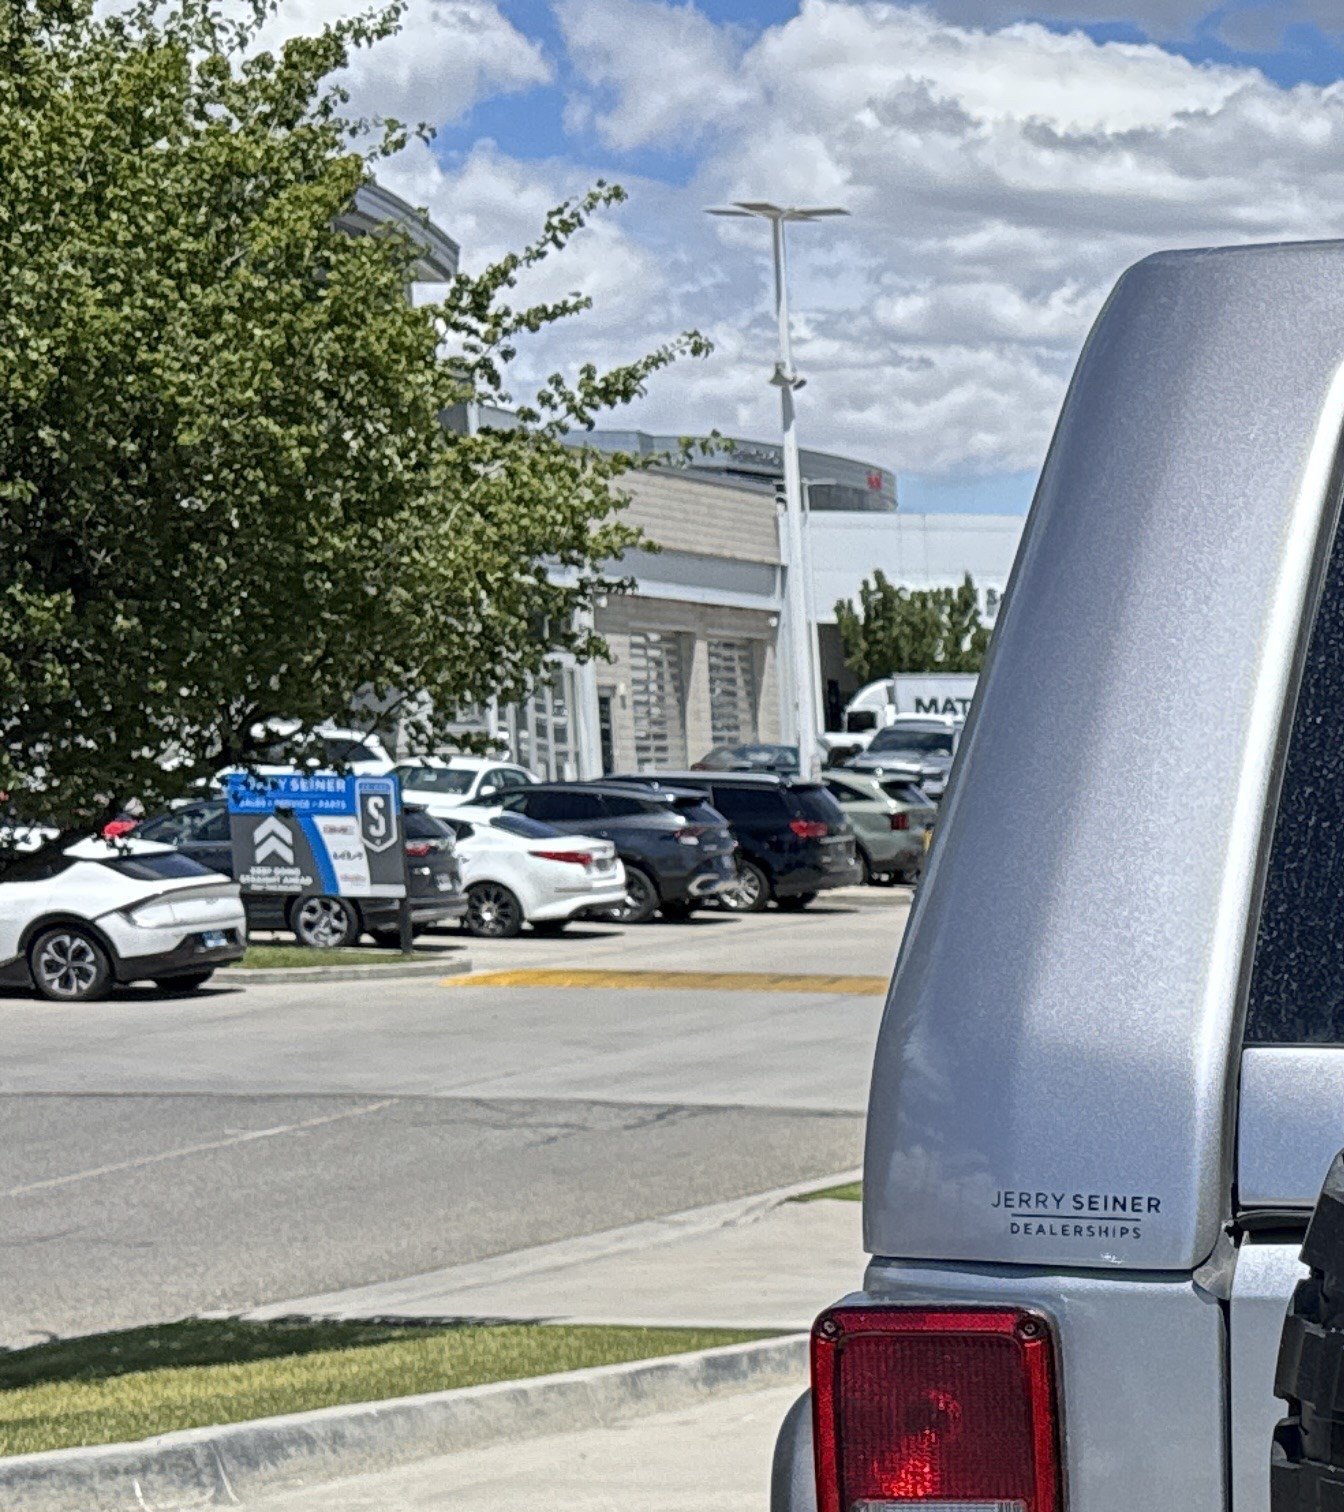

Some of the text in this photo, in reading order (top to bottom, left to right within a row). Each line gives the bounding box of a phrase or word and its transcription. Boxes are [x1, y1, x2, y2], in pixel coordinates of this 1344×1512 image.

[366, 796, 387, 837] S
[991, 1191, 1161, 1213] JERRY SEINER
[1010, 1222, 1142, 1239] DEALERSHIPS
